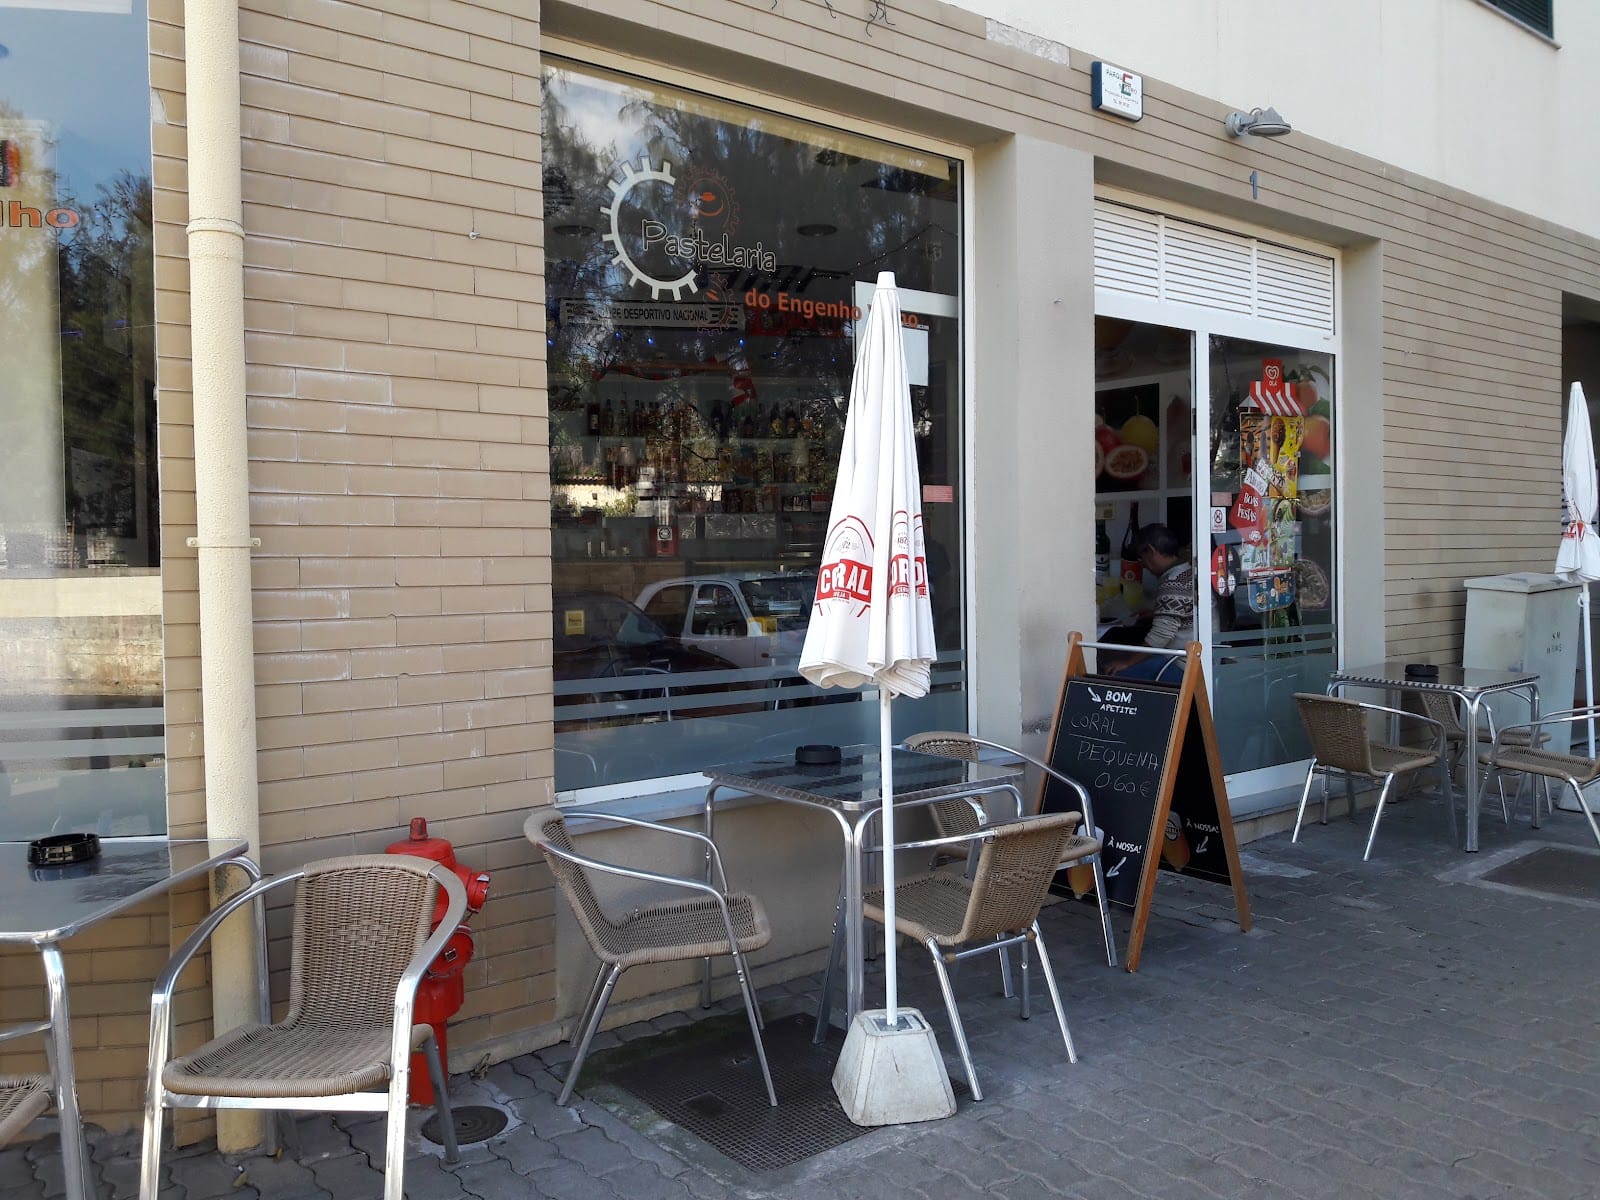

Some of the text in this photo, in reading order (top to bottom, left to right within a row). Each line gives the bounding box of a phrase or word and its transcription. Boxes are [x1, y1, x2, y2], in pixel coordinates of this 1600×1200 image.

[0, 200, 80, 228] ho
[623, 308, 671, 321] DESPORTIVO
[672, 309, 709, 322] NACIONAL
[744, 287, 771, 309] do
[777, 291, 863, 321] Engenho
[1105, 690, 1133, 704] BOM
[1099, 703, 1138, 715] APETITE!
[1070, 712, 1120, 737] CORAL
[1077, 740, 1159, 771] PEQUENA
[1107, 835, 1142, 854] À NOSSA!
